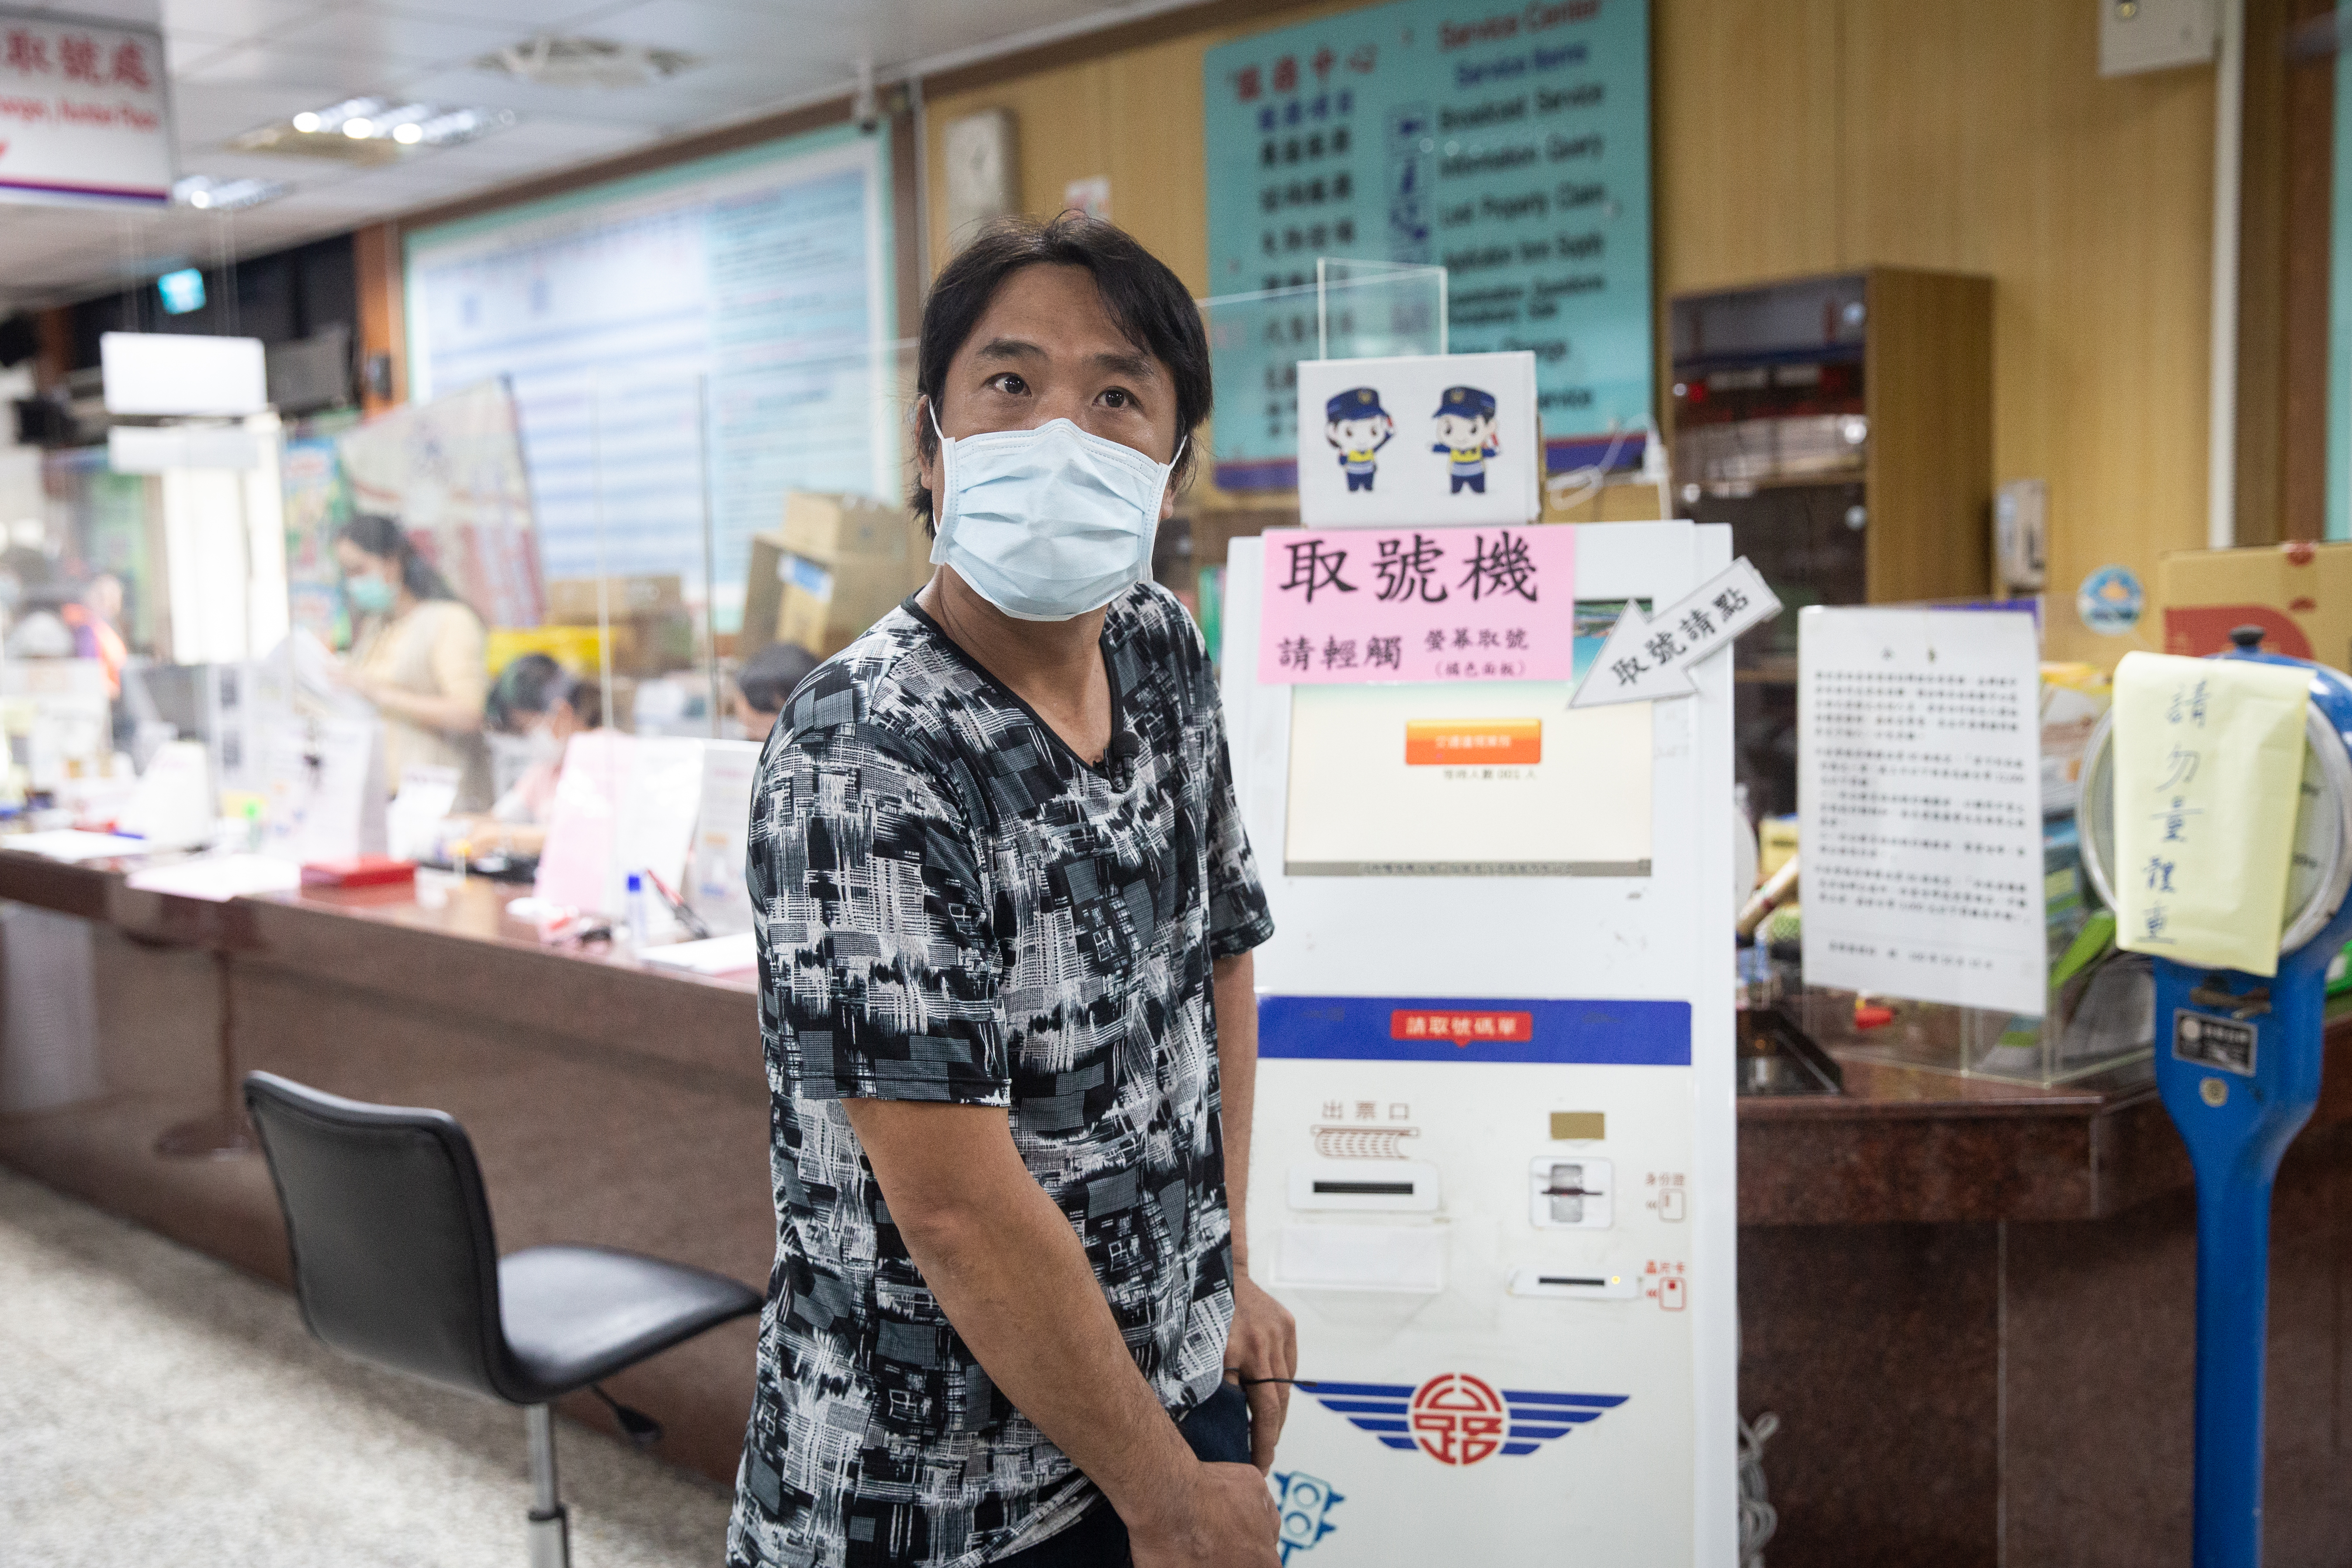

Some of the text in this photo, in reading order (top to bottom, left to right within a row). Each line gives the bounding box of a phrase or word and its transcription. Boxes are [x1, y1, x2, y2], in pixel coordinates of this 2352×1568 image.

[1280, 530, 1538, 603] 取號機
[1278, 628, 1530, 671] 請輕觸 螢幕取號
[1611, 586, 1749, 686] 取號請點
[1406, 1016, 1517, 1036] 請取號碼單
[1322, 1100, 1410, 1120] 出票口
